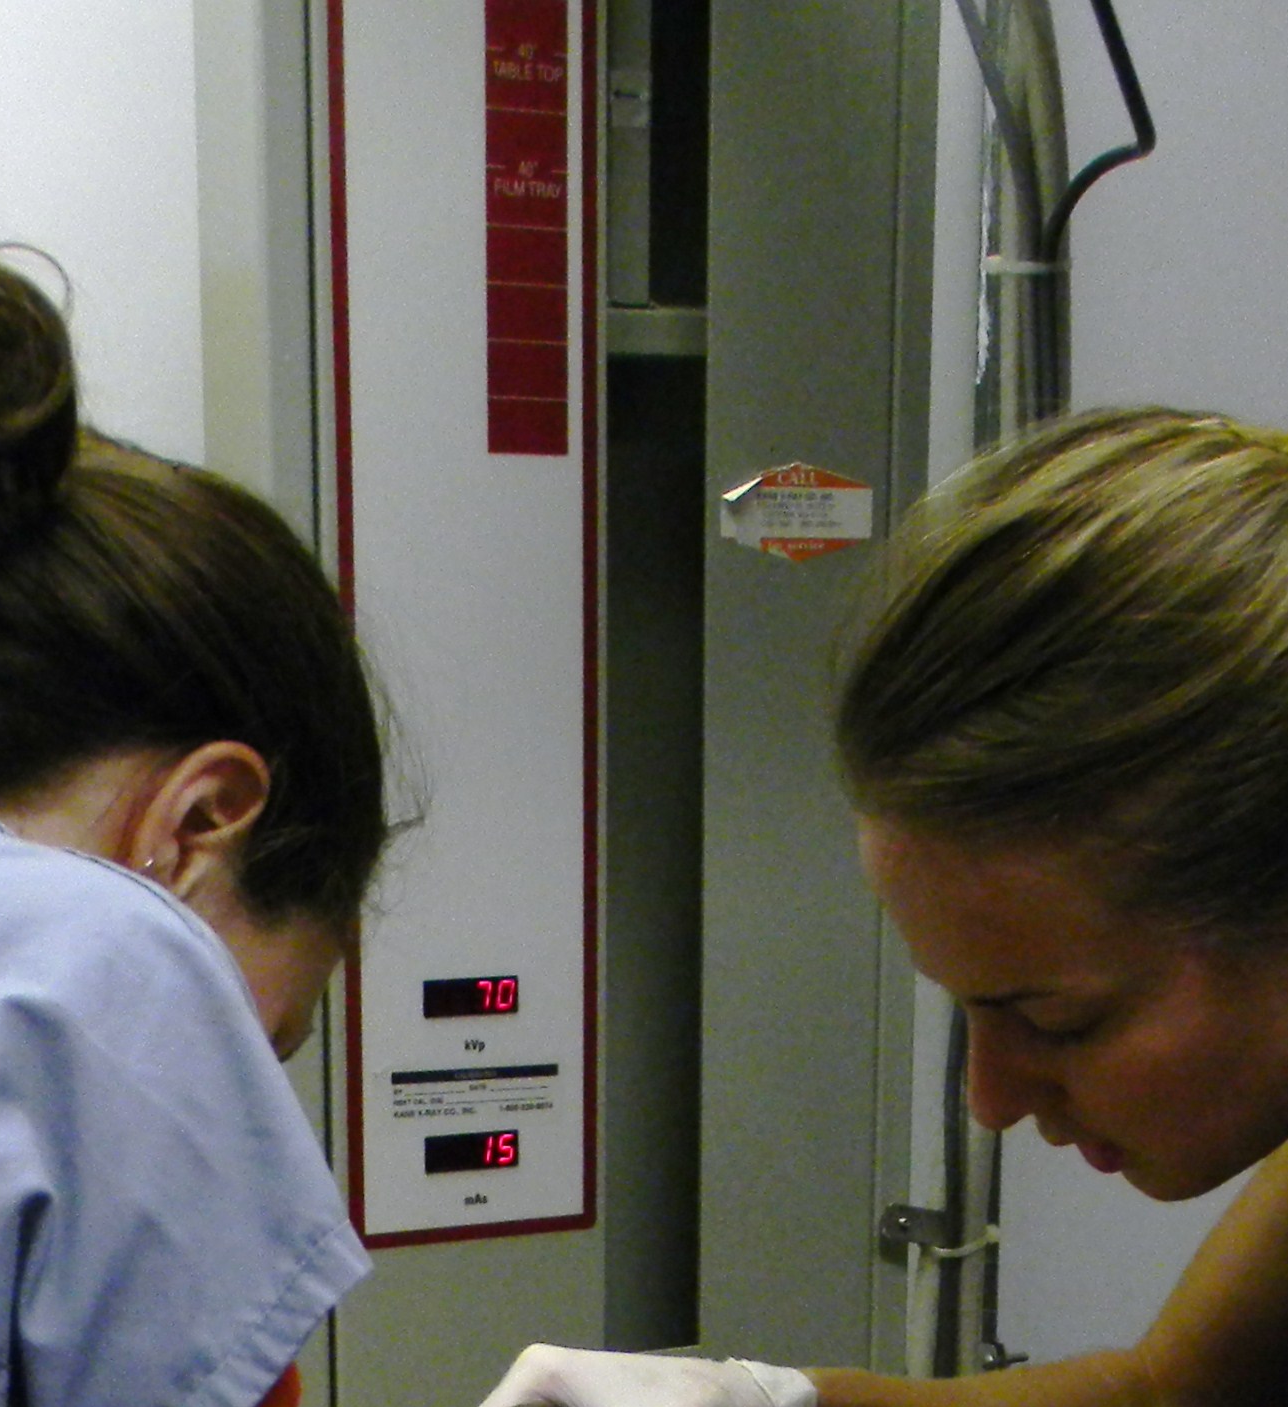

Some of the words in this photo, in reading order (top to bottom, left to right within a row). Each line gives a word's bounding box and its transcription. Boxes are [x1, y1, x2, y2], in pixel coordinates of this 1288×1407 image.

[493, 60, 533, 81] TABLE
[536, 64, 563, 82] TOP
[494, 178, 526, 197] FILM
[528, 181, 561, 198] TRAY
[476, 978, 516, 1012] 70
[464, 1039, 486, 1052] kVp
[484, 1133, 515, 1166] 15
[464, 1192, 488, 1206] mAs
